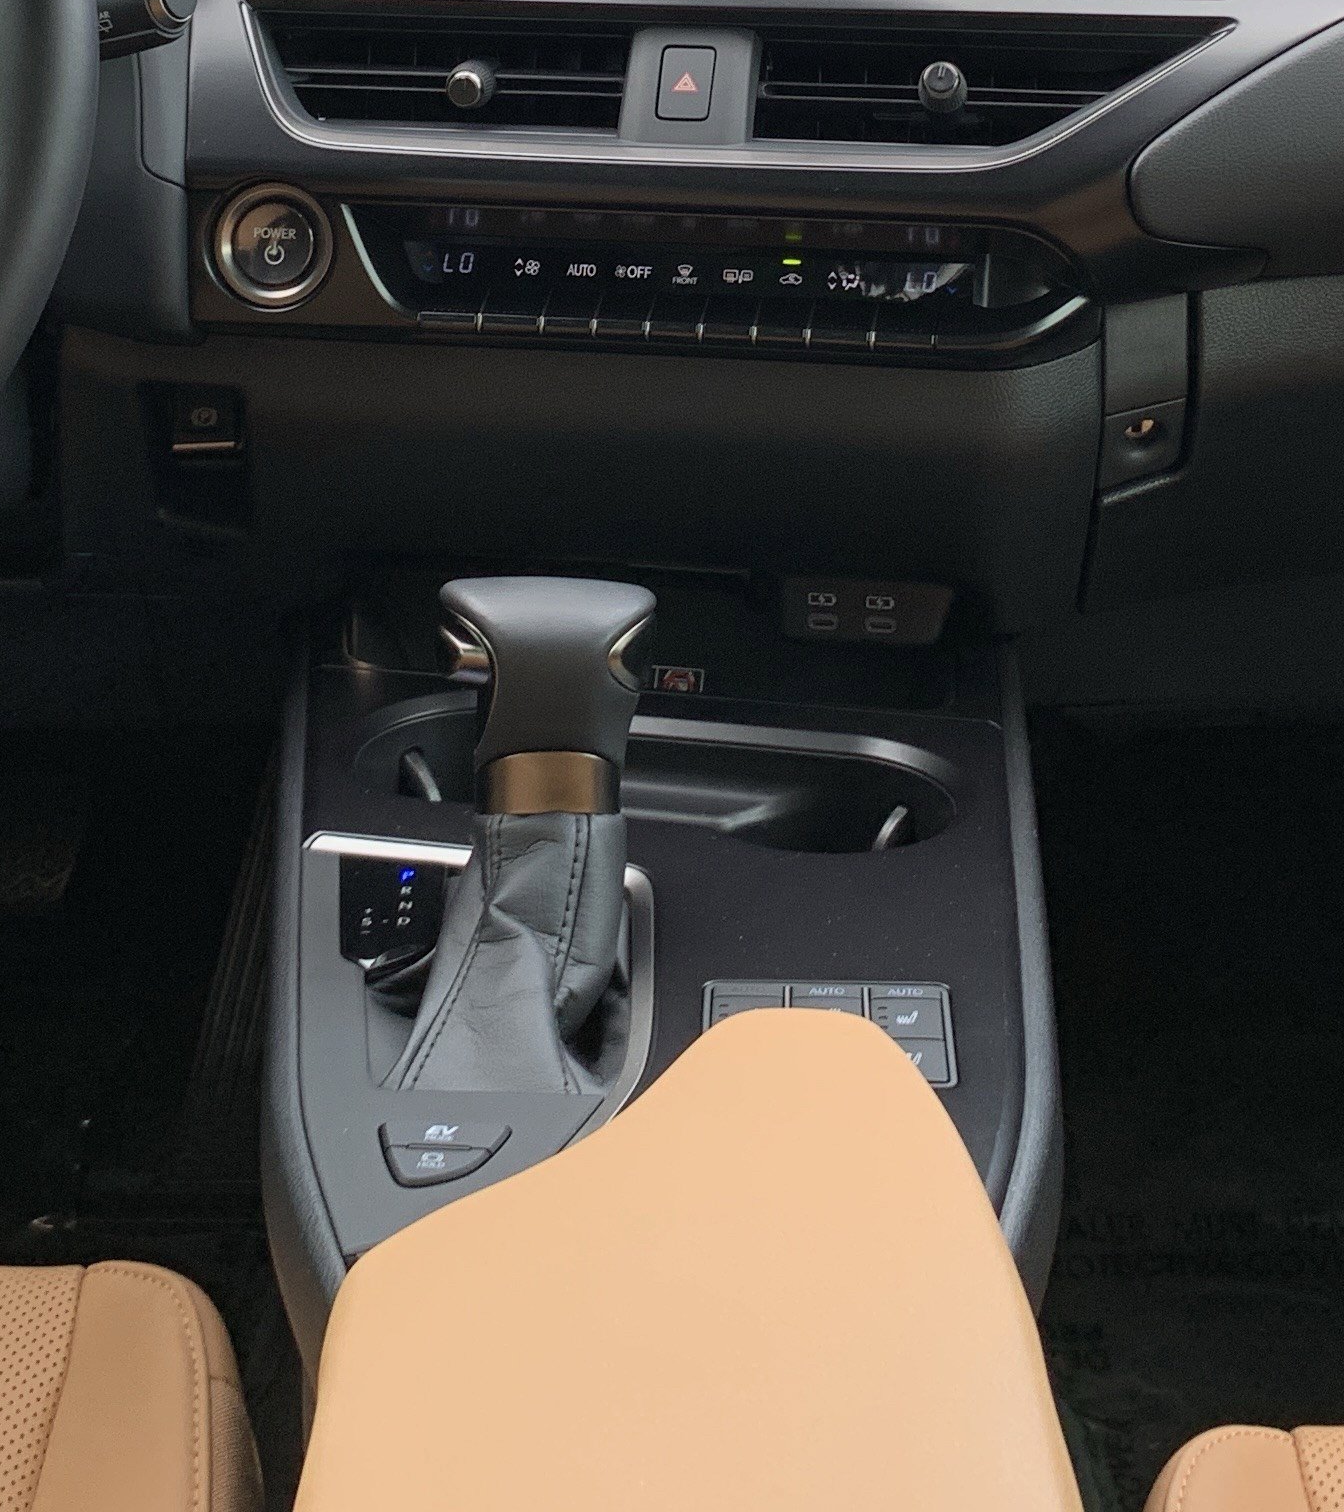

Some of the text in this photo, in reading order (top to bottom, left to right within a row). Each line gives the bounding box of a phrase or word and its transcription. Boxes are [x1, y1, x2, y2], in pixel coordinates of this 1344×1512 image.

[252, 227, 297, 240] POWER
[566, 263, 597, 278] AUTO
[626, 265, 654, 279] OFF
[671, 276, 698, 285] FRONT
[808, 987, 846, 996] AUTO
[886, 988, 924, 997] AUTO
